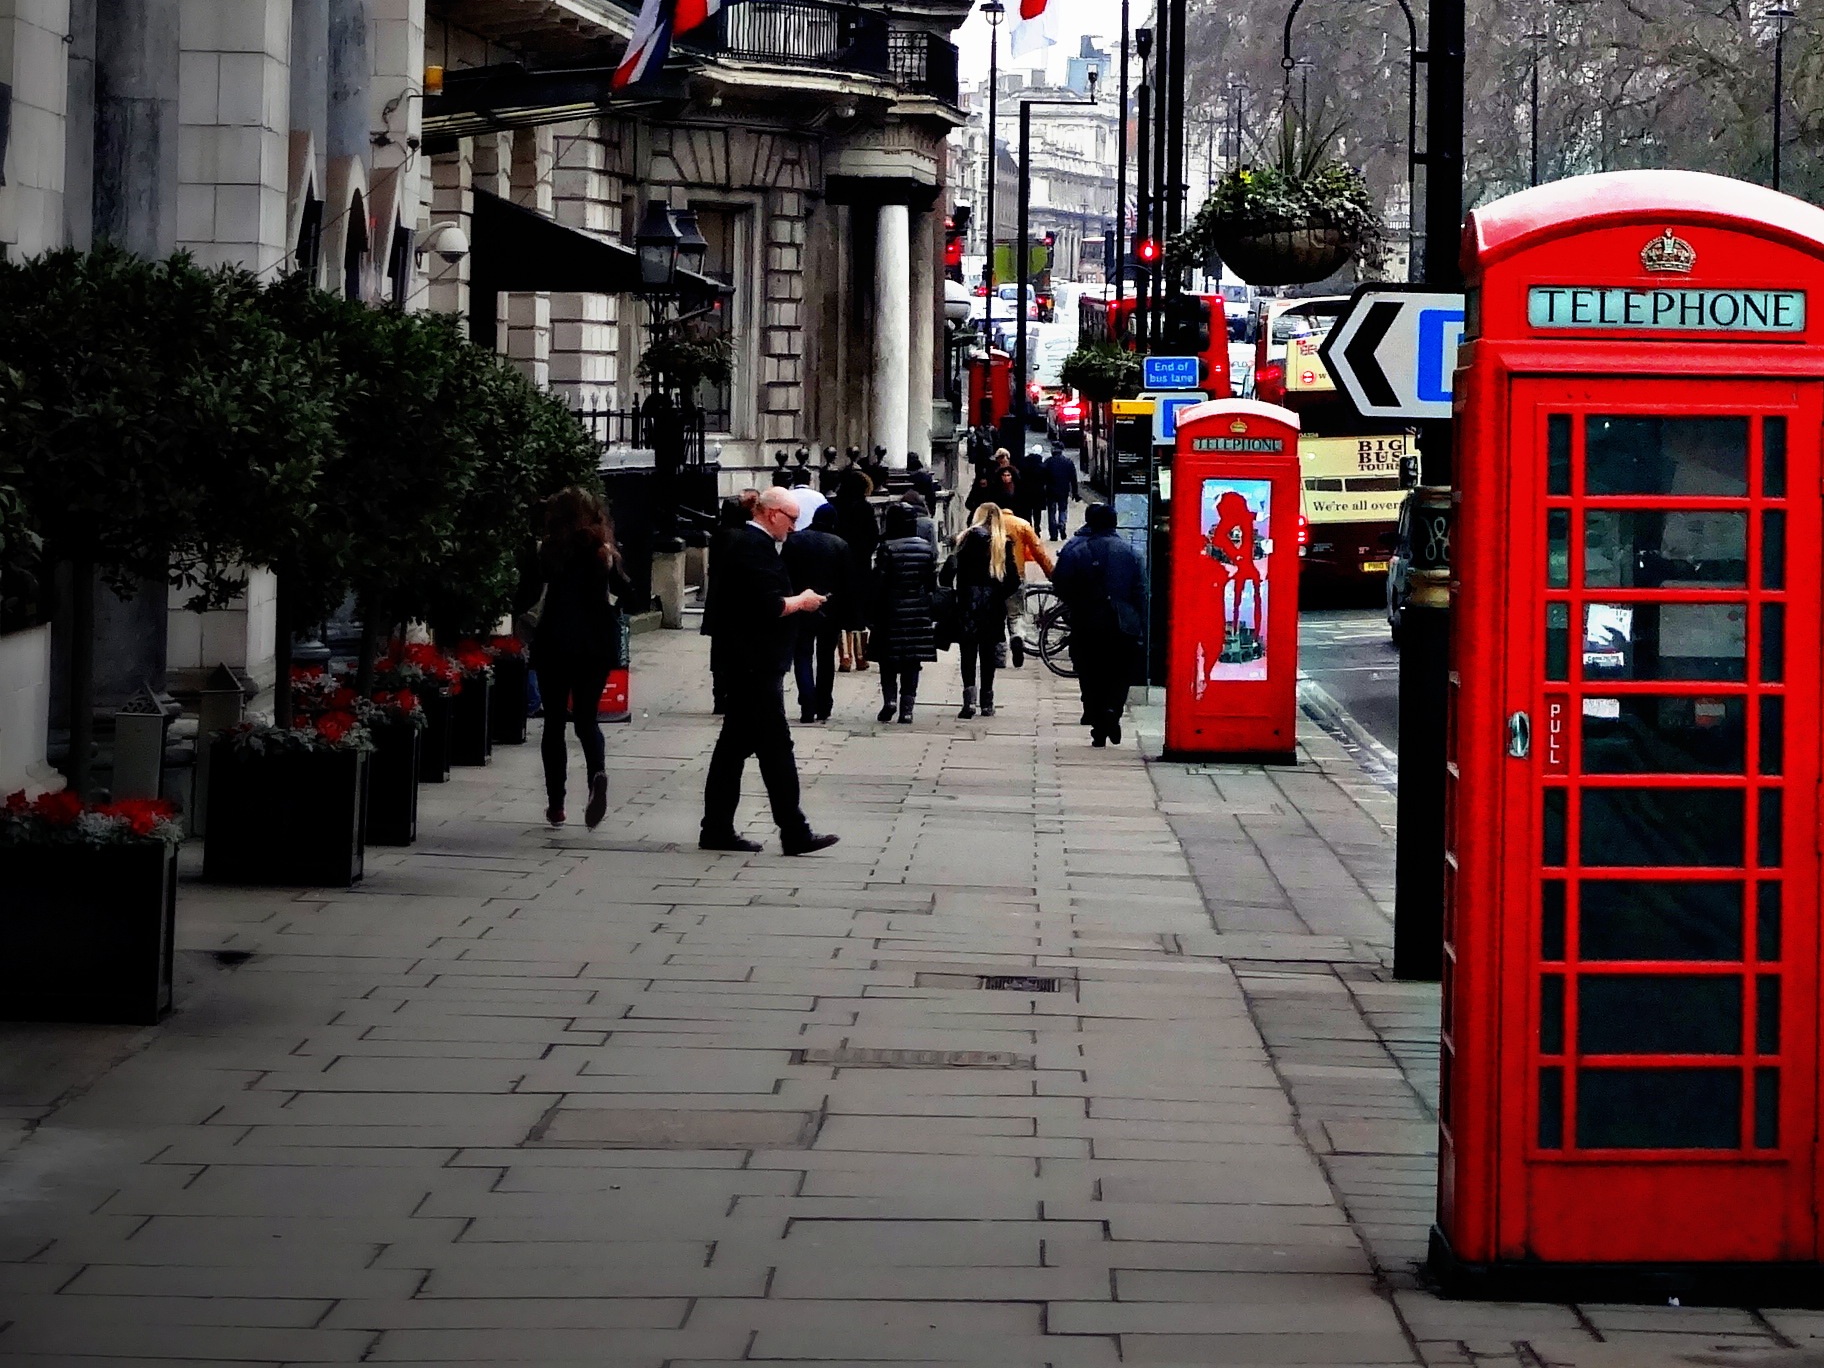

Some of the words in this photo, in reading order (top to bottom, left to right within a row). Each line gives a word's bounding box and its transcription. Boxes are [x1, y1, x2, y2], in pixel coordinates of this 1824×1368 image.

[1538, 289, 1794, 327] TELEPHONE
[1154, 361, 1175, 371] End
[1177, 361, 1190, 371] of
[1149, 373, 1168, 383] bus
[1171, 373, 1194, 383] lane
[1198, 437, 1281, 451] TELEPHONE
[1358, 440, 1402, 452] BIG
[1358, 451, 1402, 463] BUS
[1313, 500, 1348, 511] We're
[1352, 500, 1367, 511] all
[1550, 703, 1561, 764] PULL
